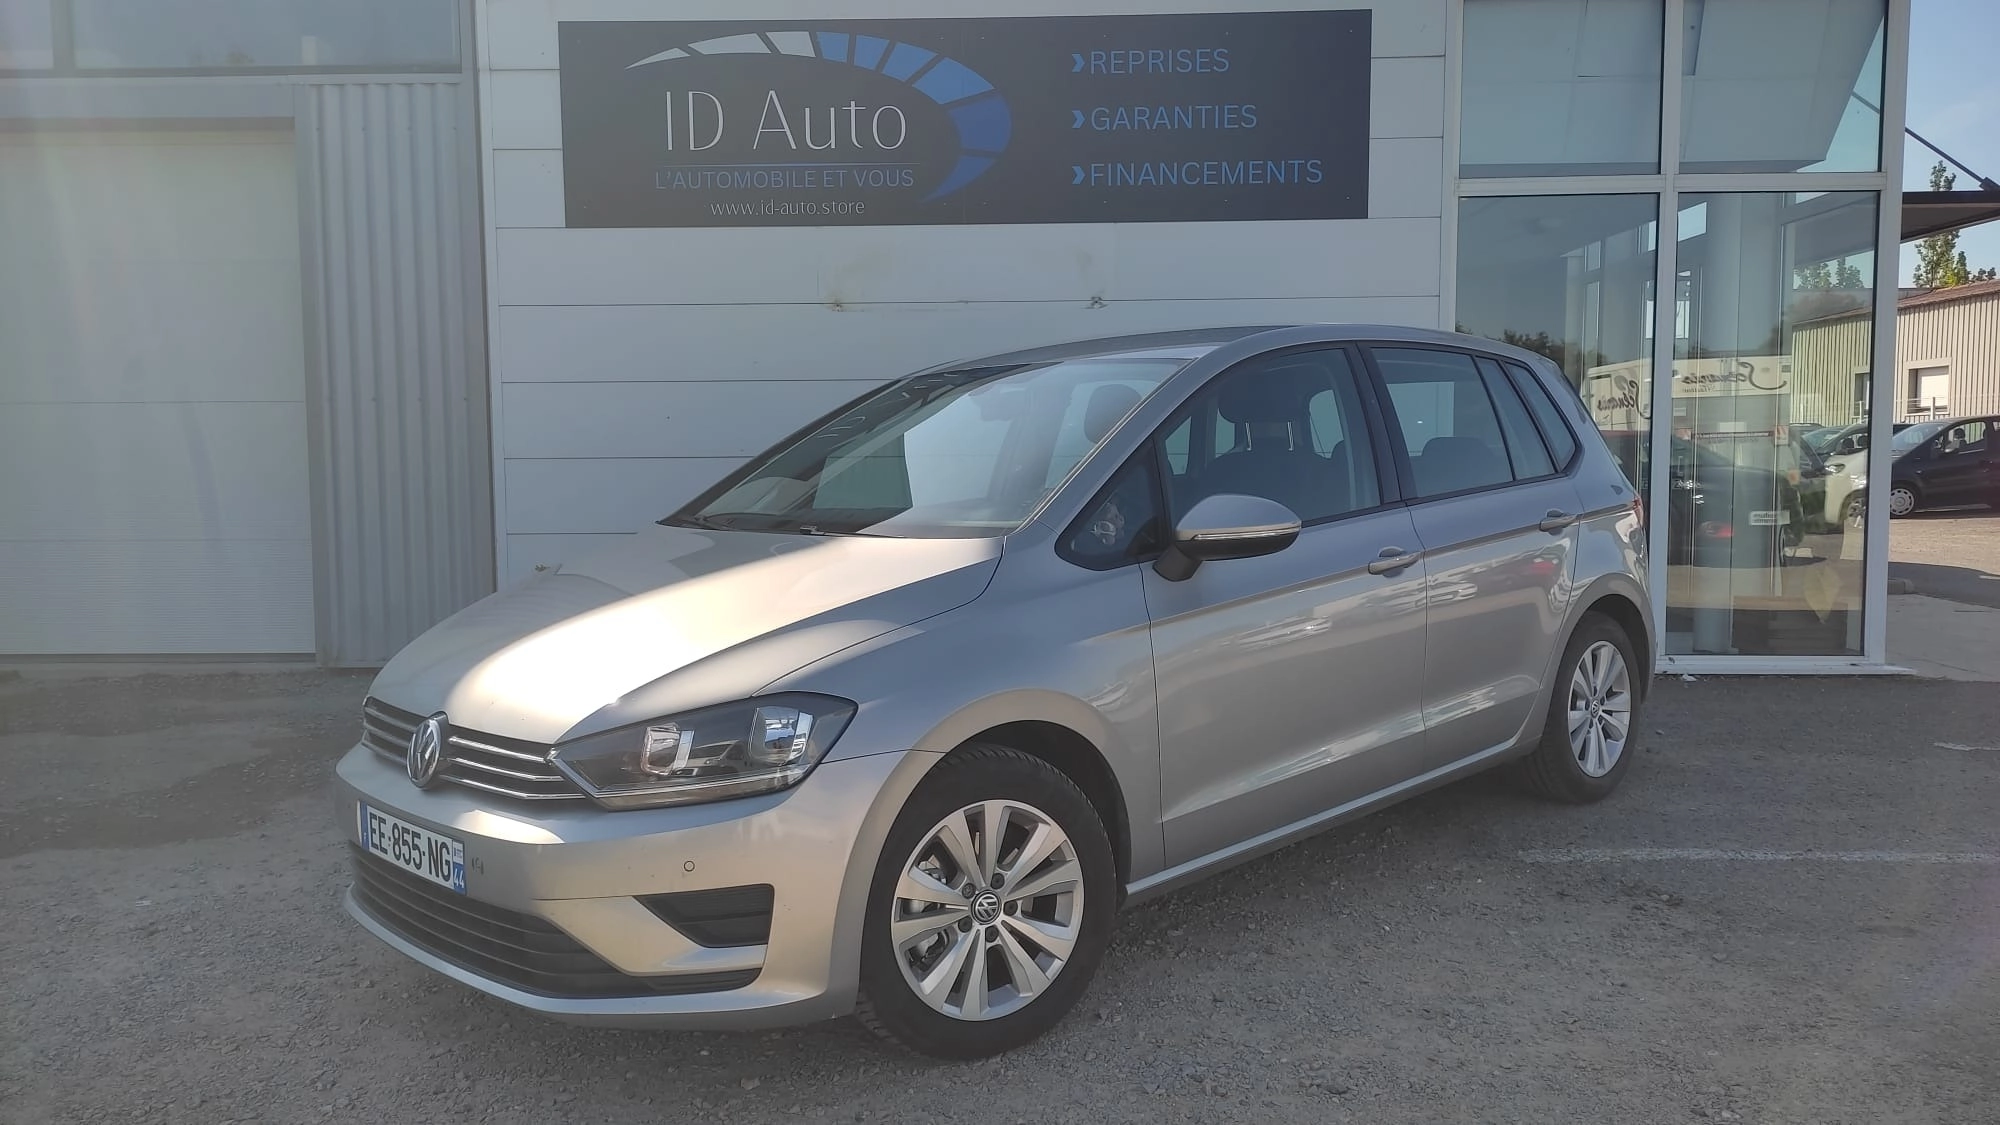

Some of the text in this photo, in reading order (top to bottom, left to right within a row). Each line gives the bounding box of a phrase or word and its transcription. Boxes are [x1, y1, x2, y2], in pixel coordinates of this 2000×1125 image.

[1089, 48, 1230, 75] REPRISES
[665, 89, 908, 152] ID Auto
[1090, 104, 1258, 131] GARANTIES
[655, 169, 915, 190] L'AUTOMOBILE ET VOUS
[1090, 159, 1324, 187] FINANCEMENTS
[710, 199, 866, 216] www.id-auto.store
